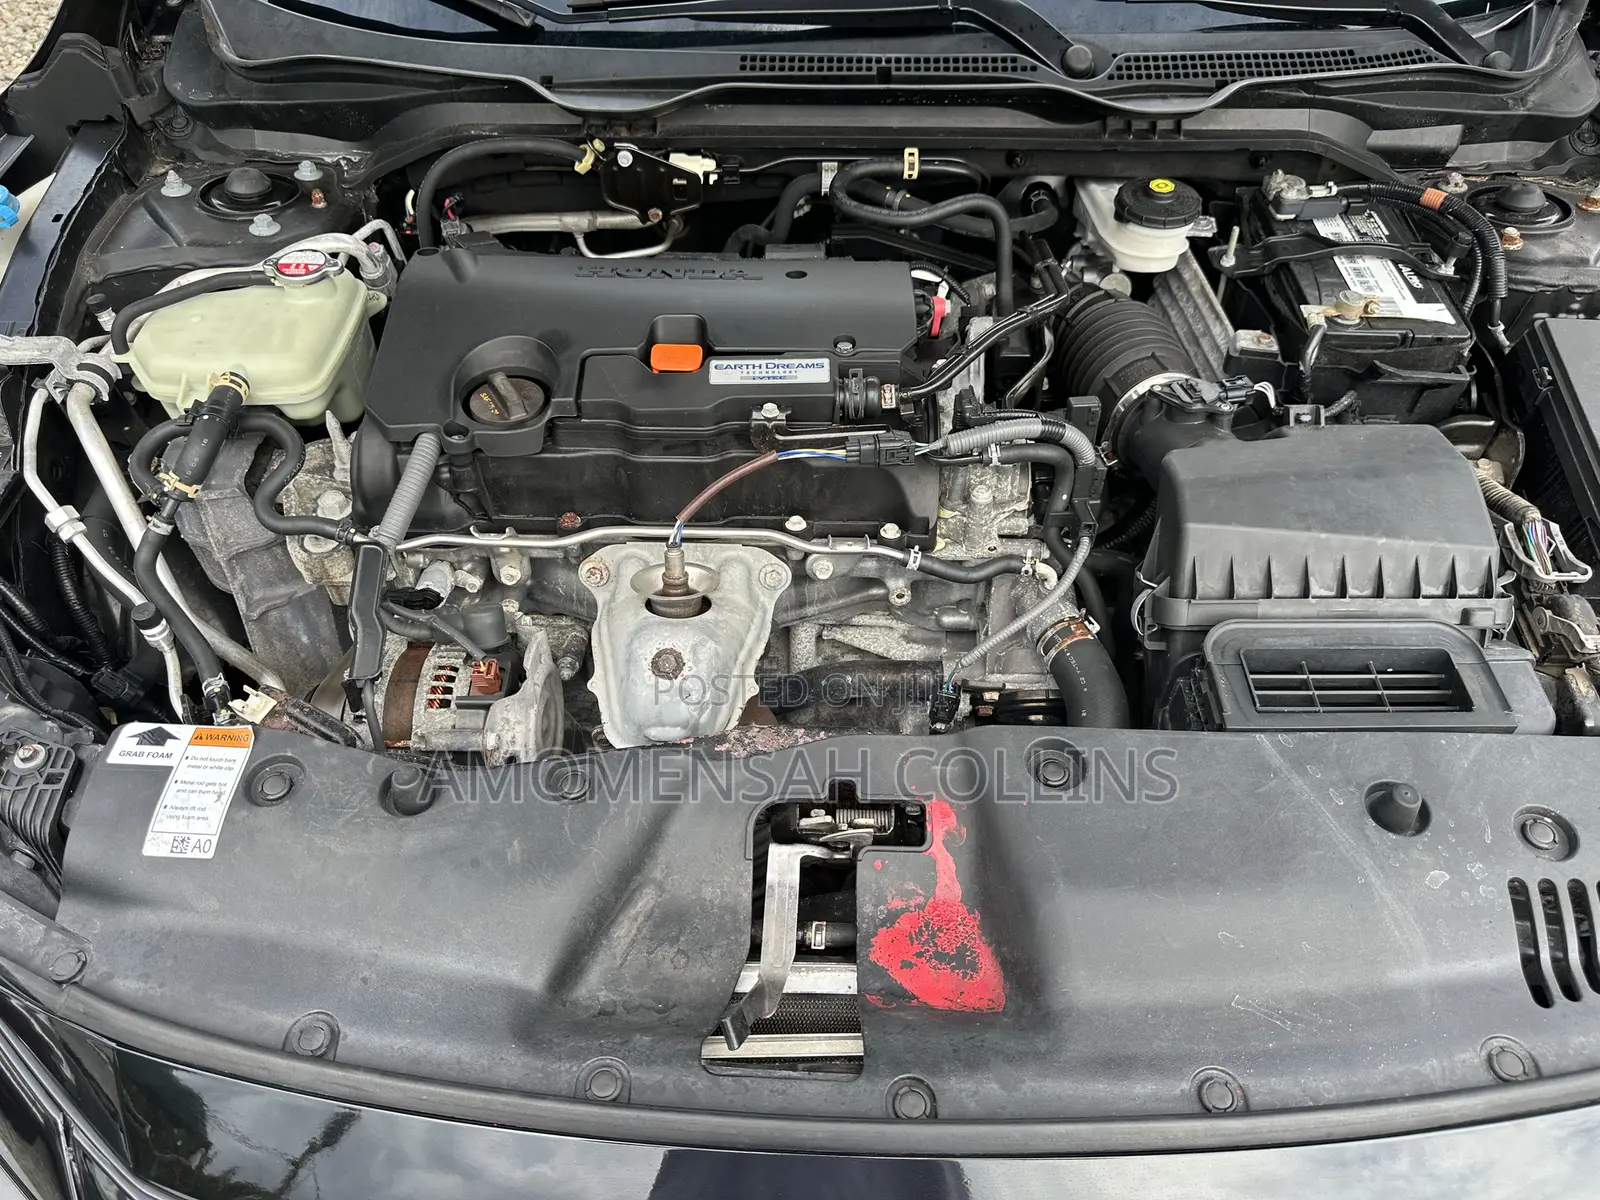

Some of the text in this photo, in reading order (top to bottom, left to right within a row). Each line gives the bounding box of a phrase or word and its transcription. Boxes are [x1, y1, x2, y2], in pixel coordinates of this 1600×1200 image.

[575, 266, 763, 280] HONDA
[714, 362, 825, 371] EARTH DREAMS
[205, 733, 251, 742] WARNING
[118, 750, 173, 759] GRAB FOAM
[169, 804, 189, 812] Always
[190, 838, 212, 854] A0
